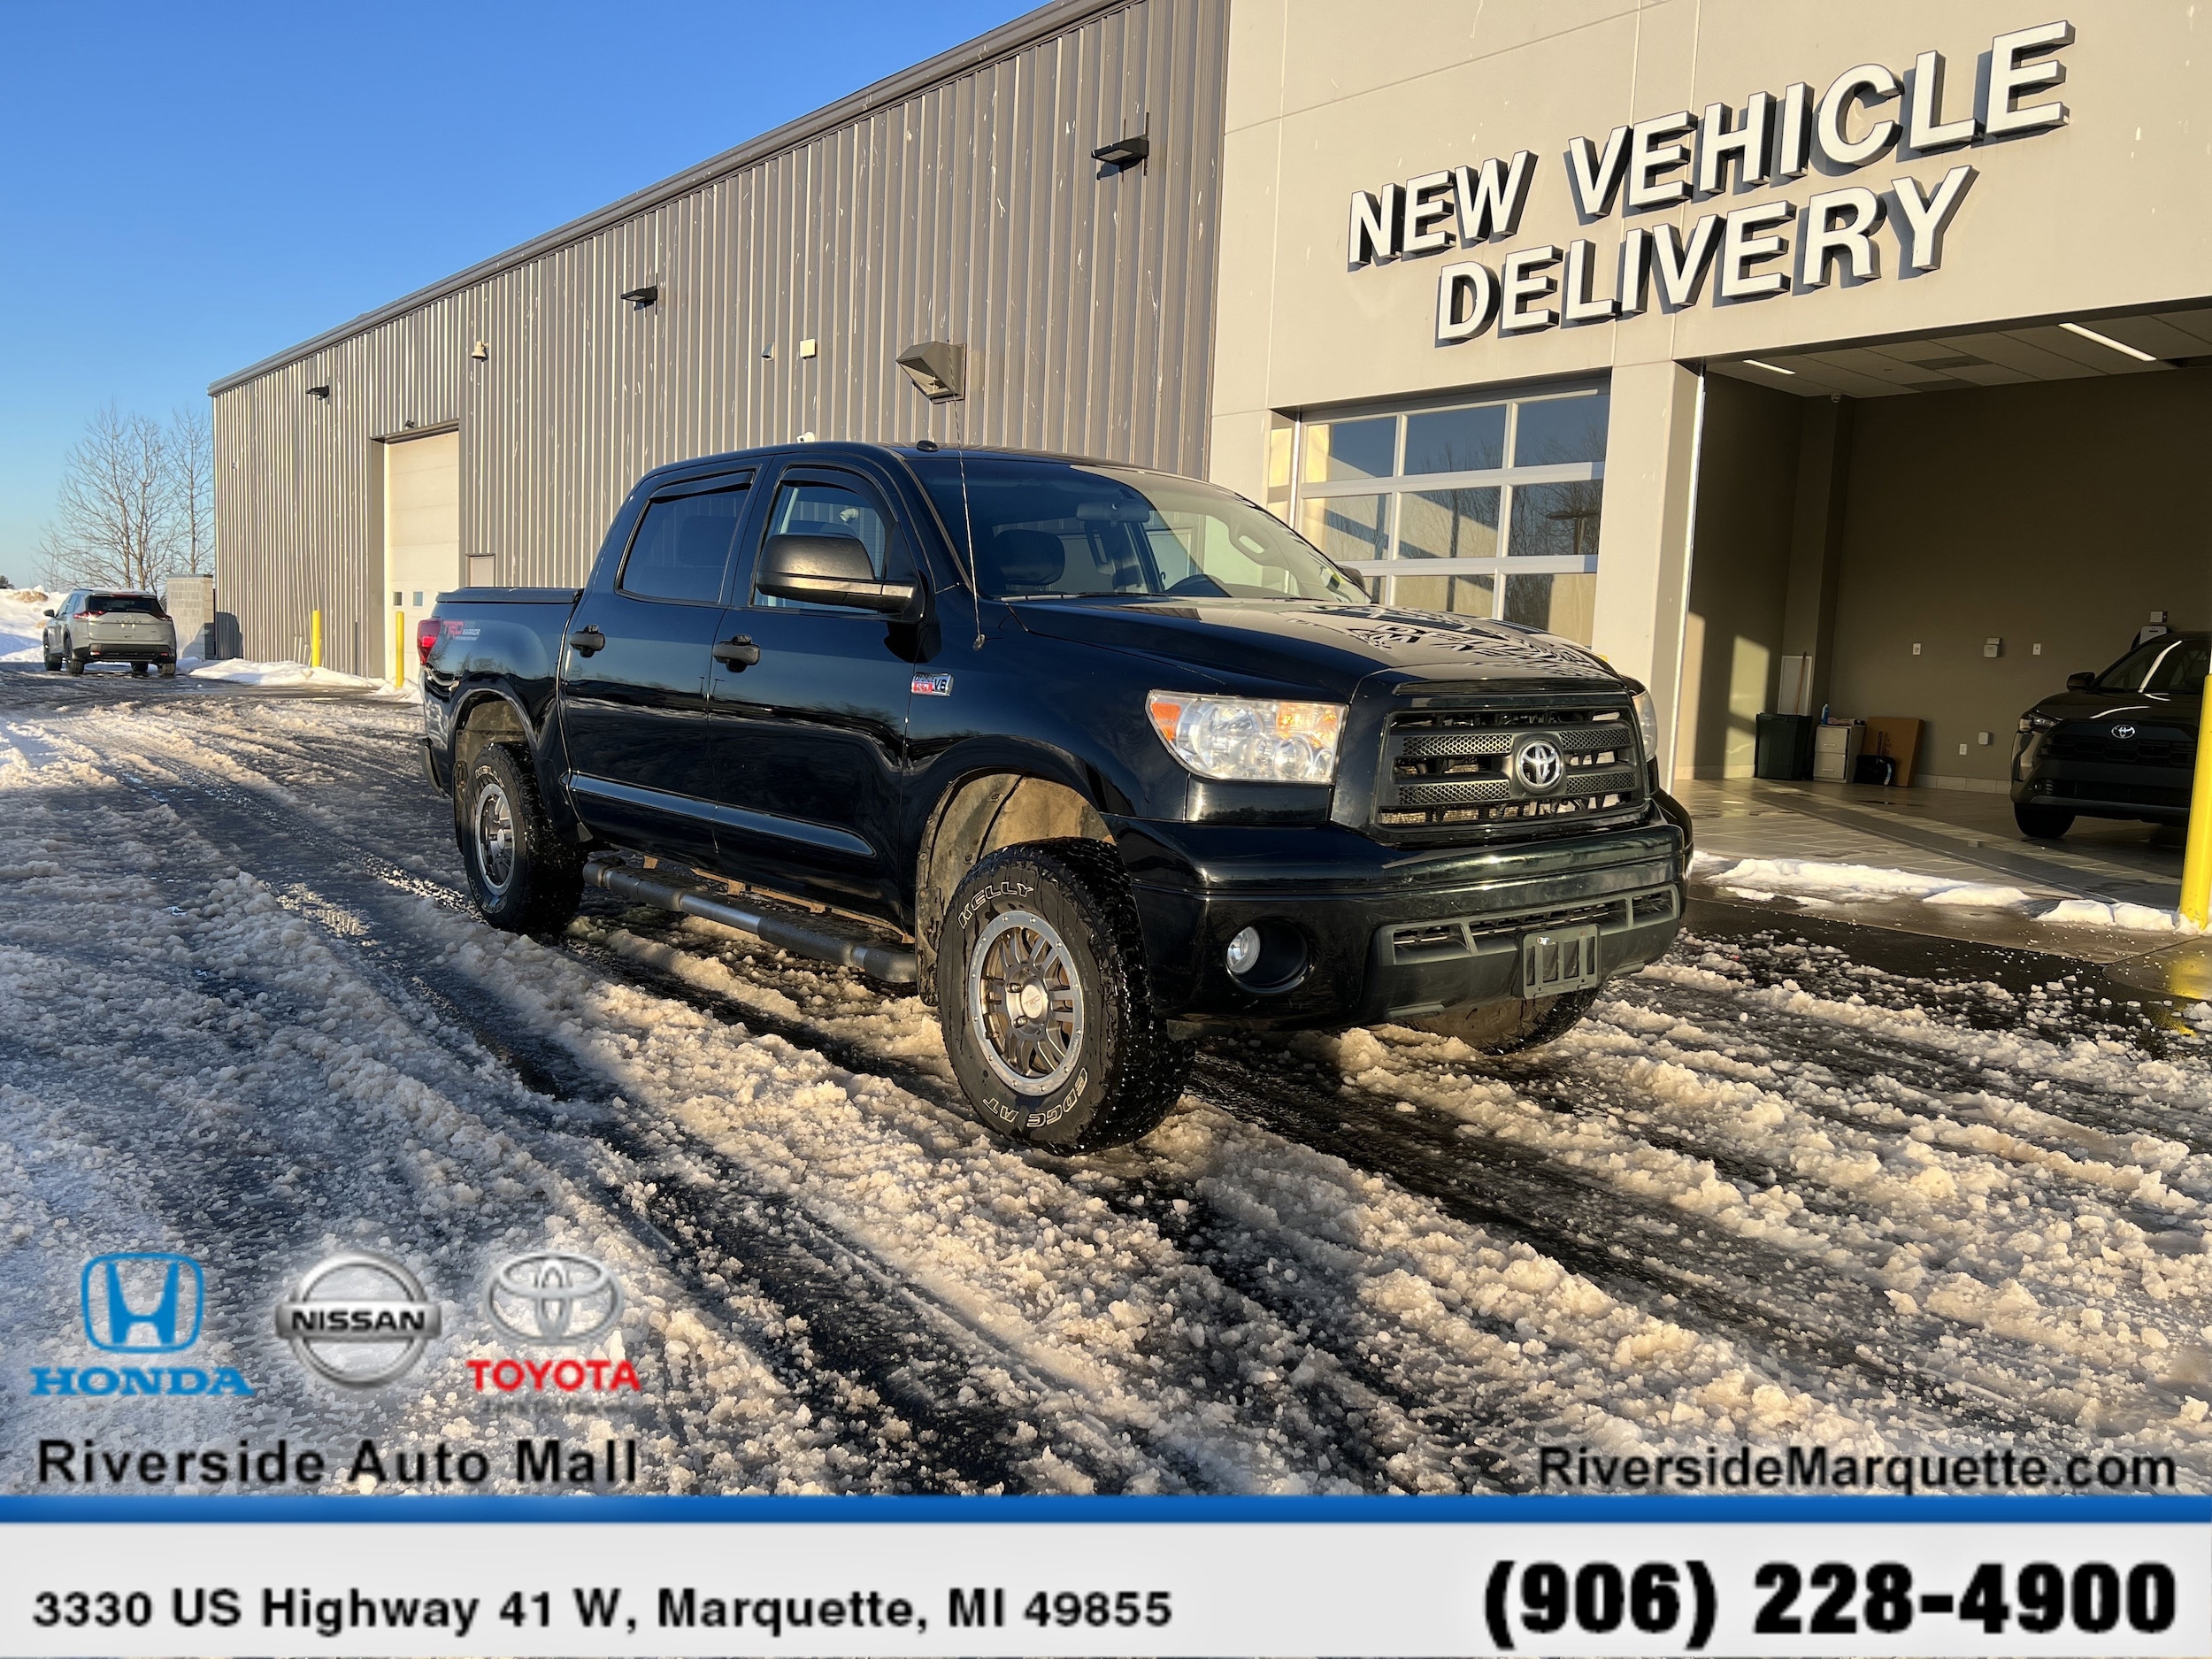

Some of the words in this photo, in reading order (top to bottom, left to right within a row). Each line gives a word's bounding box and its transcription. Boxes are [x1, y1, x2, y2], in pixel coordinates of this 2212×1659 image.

[1348, 150, 1538, 269] NEW
[1568, 19, 2075, 224] VEHICLE
[1436, 165, 1978, 346] DELIVERY
[957, 881, 1034, 930] KELLY
[982, 1097, 1020, 1124] AT
[1025, 1066, 1089, 1128] EDGE
